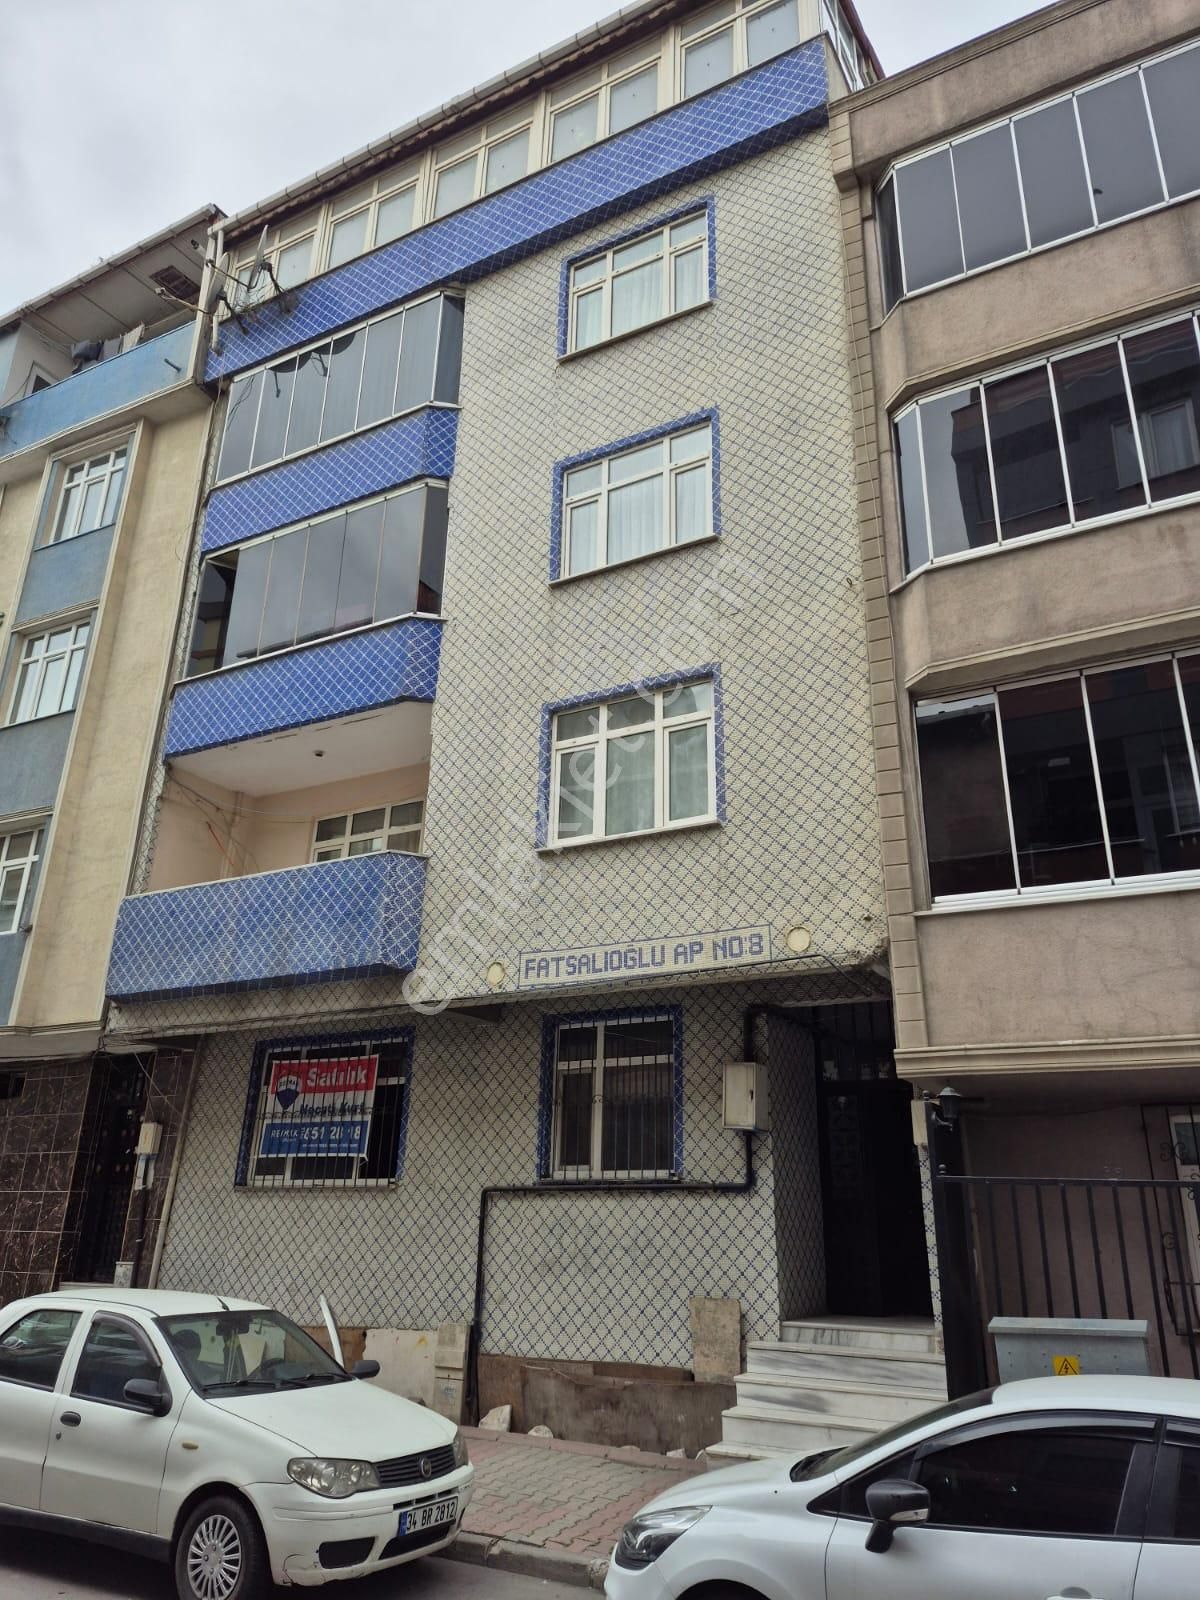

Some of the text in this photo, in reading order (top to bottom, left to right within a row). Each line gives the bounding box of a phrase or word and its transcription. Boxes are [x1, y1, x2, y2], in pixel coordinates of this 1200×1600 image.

[524, 944, 666, 979] FATSALIOĞLU
[674, 941, 703, 964] AP
[406, 1501, 456, 1530] 34 BR 2812
